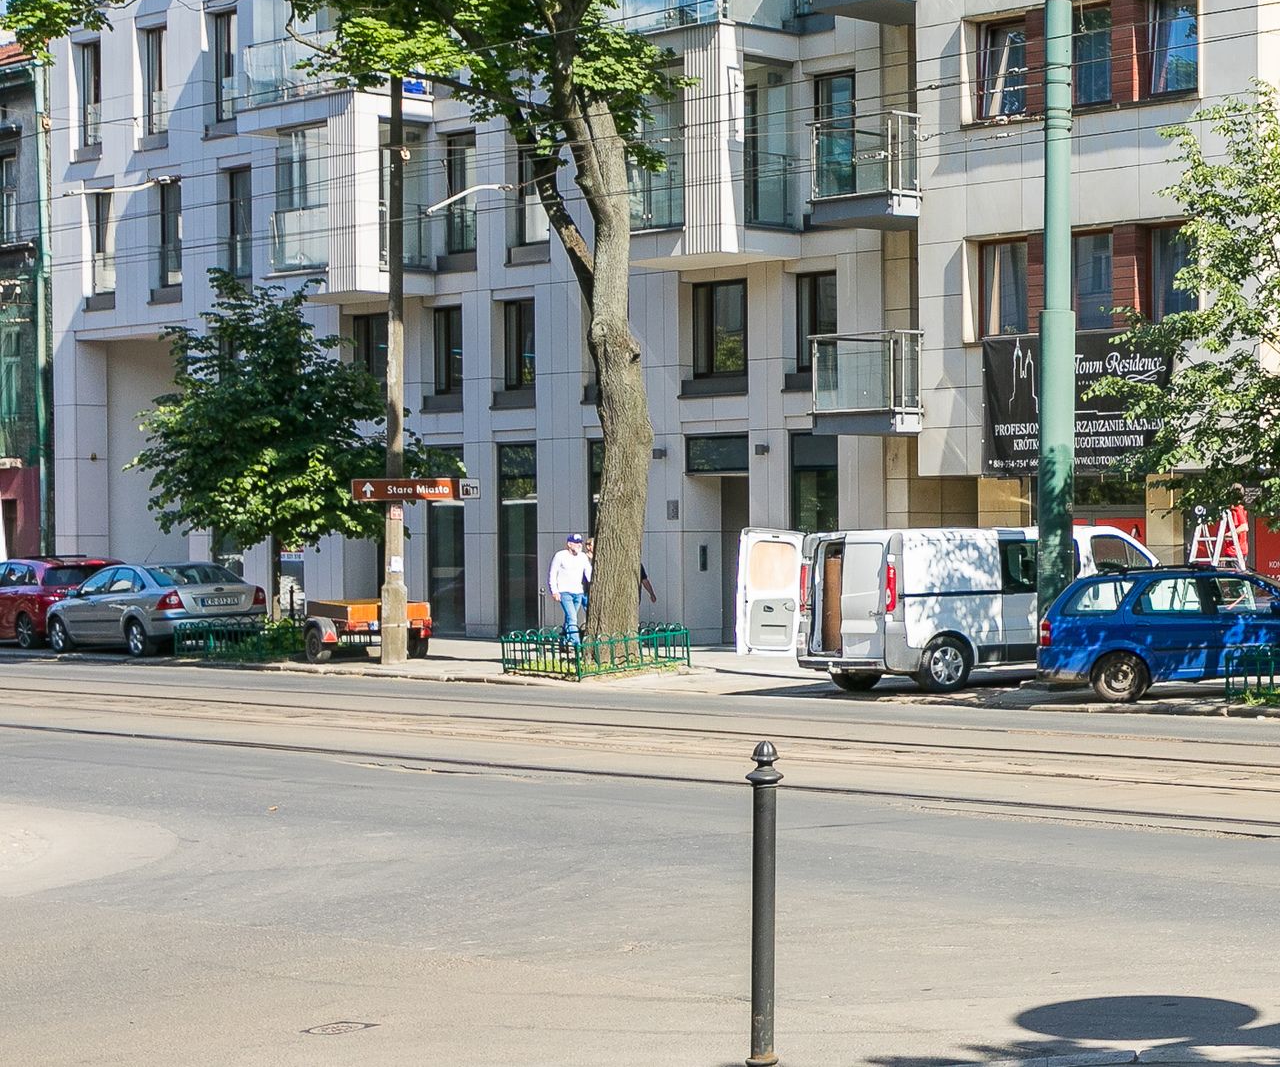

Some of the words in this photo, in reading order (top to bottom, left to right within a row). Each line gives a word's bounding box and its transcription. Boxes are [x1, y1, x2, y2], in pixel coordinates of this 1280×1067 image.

[1106, 352, 1166, 381] Residence
[995, 423, 1039, 435] PROFESJON
[1075, 419, 1124, 434] RZĄDZANIE
[1013, 437, 1039, 450] KRÓTK
[1075, 436, 1143, 448] UGOTERMINOWYM
[387, 485, 413, 494] Stare
[416, 485, 450, 494] Miasto
